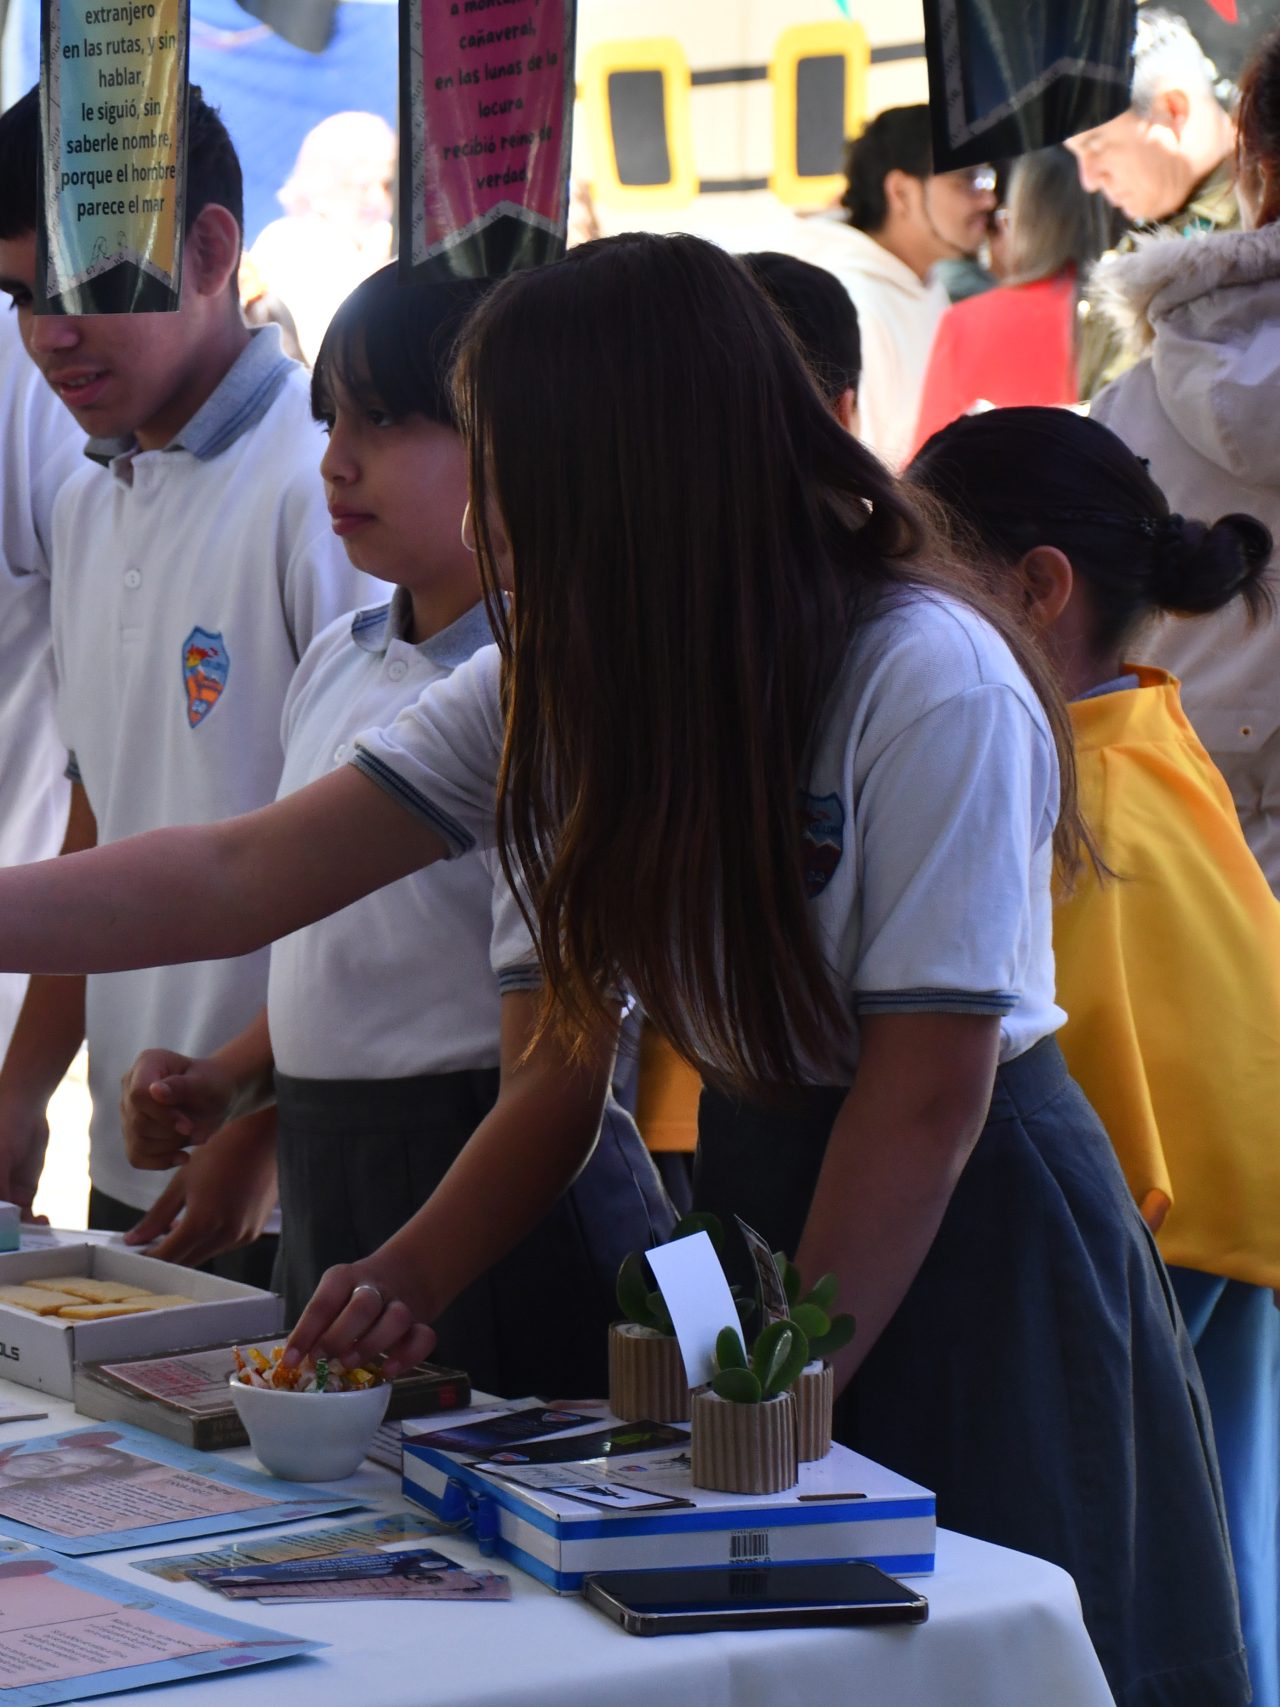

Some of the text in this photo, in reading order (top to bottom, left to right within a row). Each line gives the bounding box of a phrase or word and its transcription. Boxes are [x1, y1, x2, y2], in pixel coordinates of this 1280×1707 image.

[85, 2, 155, 26] extranjero
[63, 31, 176, 59] en las rutas, y sin
[459, 16, 536, 50] cañaveral,
[99, 67, 145, 88] hablar,
[435, 47, 558, 91] en las lunas de la
[81, 97, 162, 124] le siguió, sin
[478, 97, 524, 118] locura
[67, 129, 172, 154] saberle nombre,
[443, 134, 497, 160] recibió
[61, 161, 176, 191] porque el hombre
[77, 194, 166, 221] parece el mar
